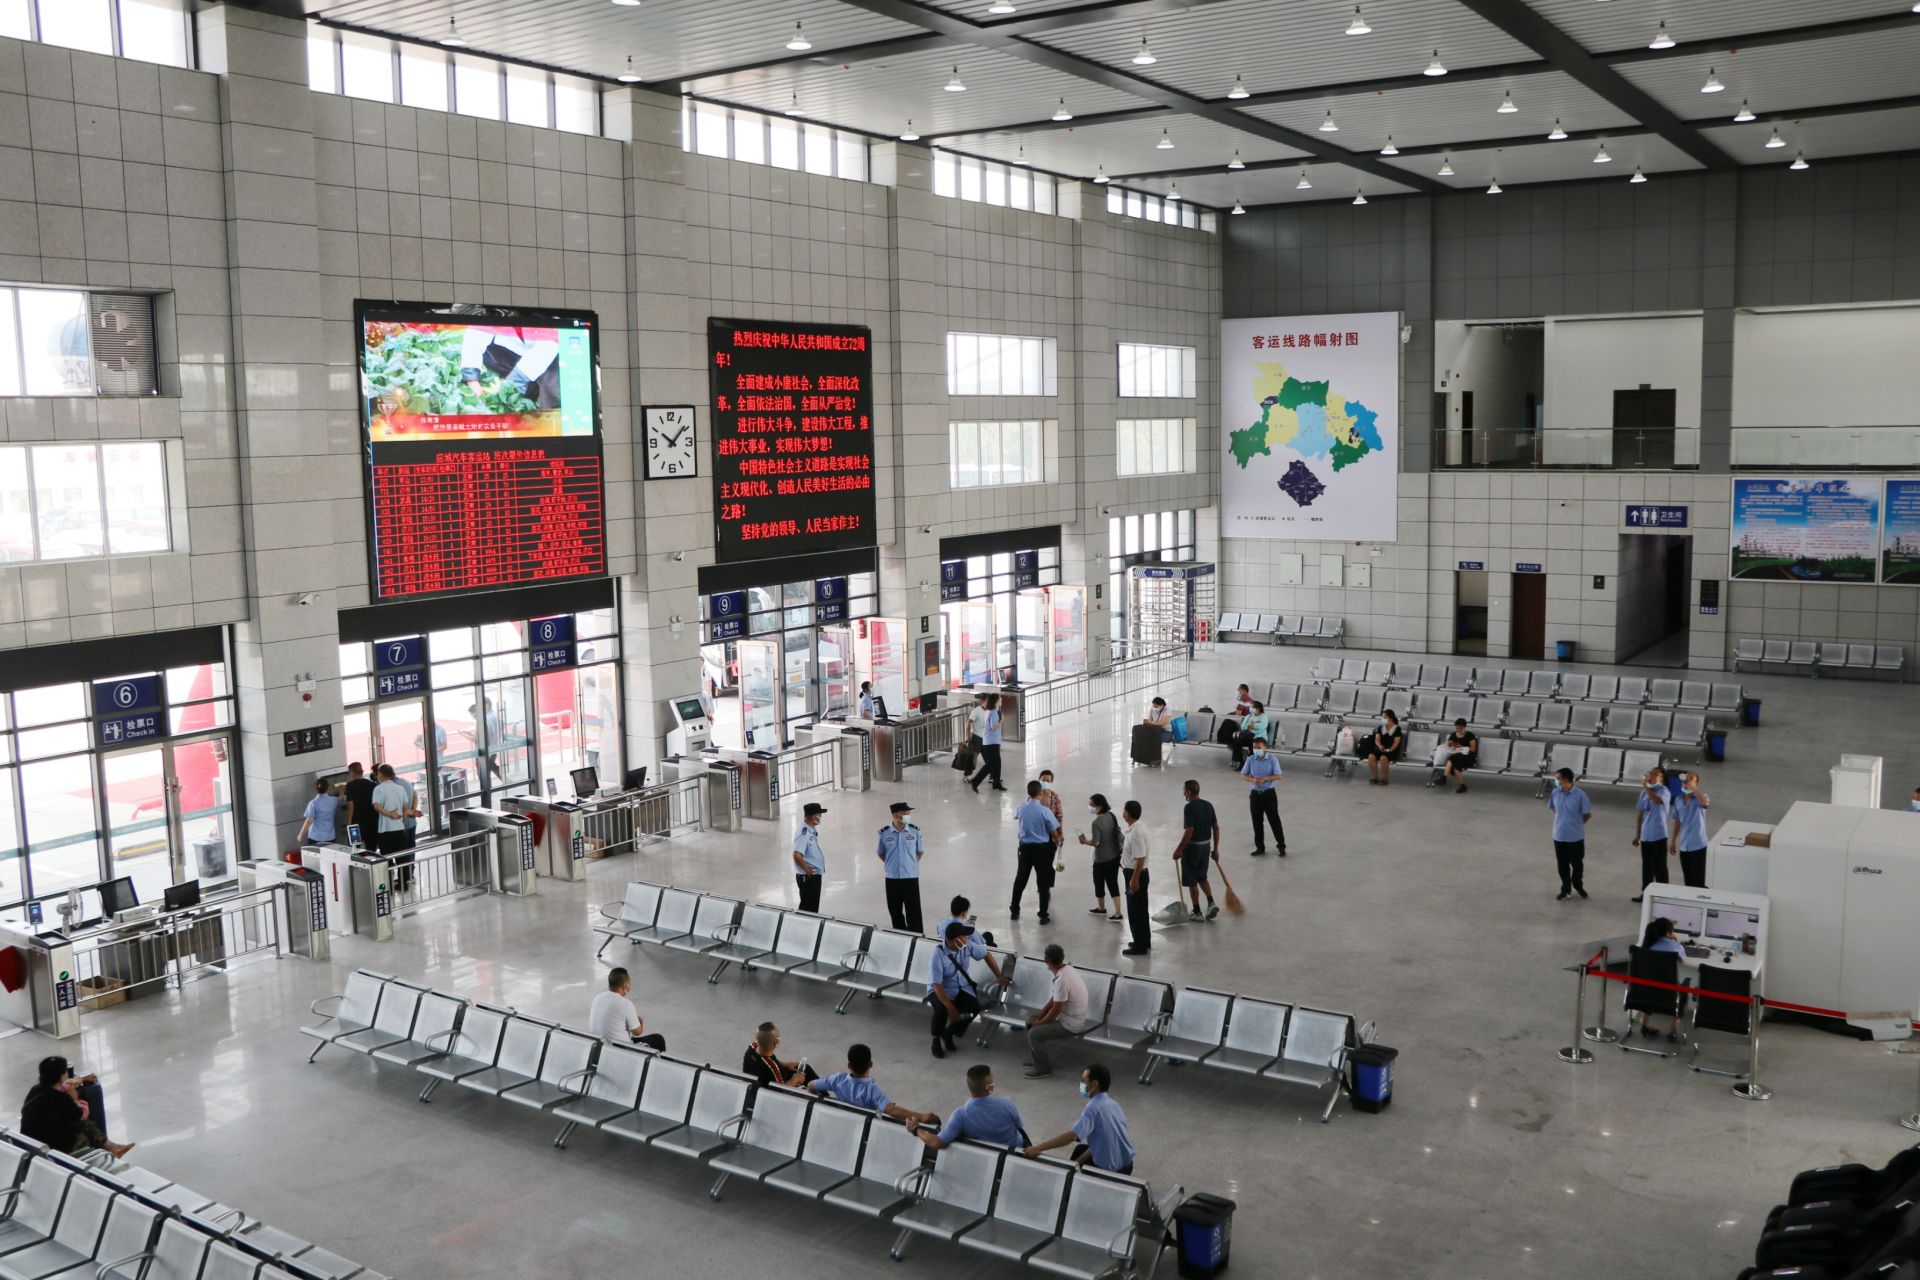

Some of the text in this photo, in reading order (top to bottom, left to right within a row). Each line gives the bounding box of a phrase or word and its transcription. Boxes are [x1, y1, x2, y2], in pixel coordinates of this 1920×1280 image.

[667, 412, 675, 421] 12
[649, 438, 658, 448] 9
[685, 437, 693, 446] 3
[669, 464, 677, 473] 6
[824, 583, 831, 596] 10
[721, 598, 728, 611] 9
[544, 624, 552, 638] 8
[392, 646, 401, 662] 7
[547, 650, 565, 659] 检票口
[397, 674, 418, 684] 检票口
[120, 686, 132, 704] 6
[126, 718, 154, 730] 检票口
[126, 729, 147, 738] Check
